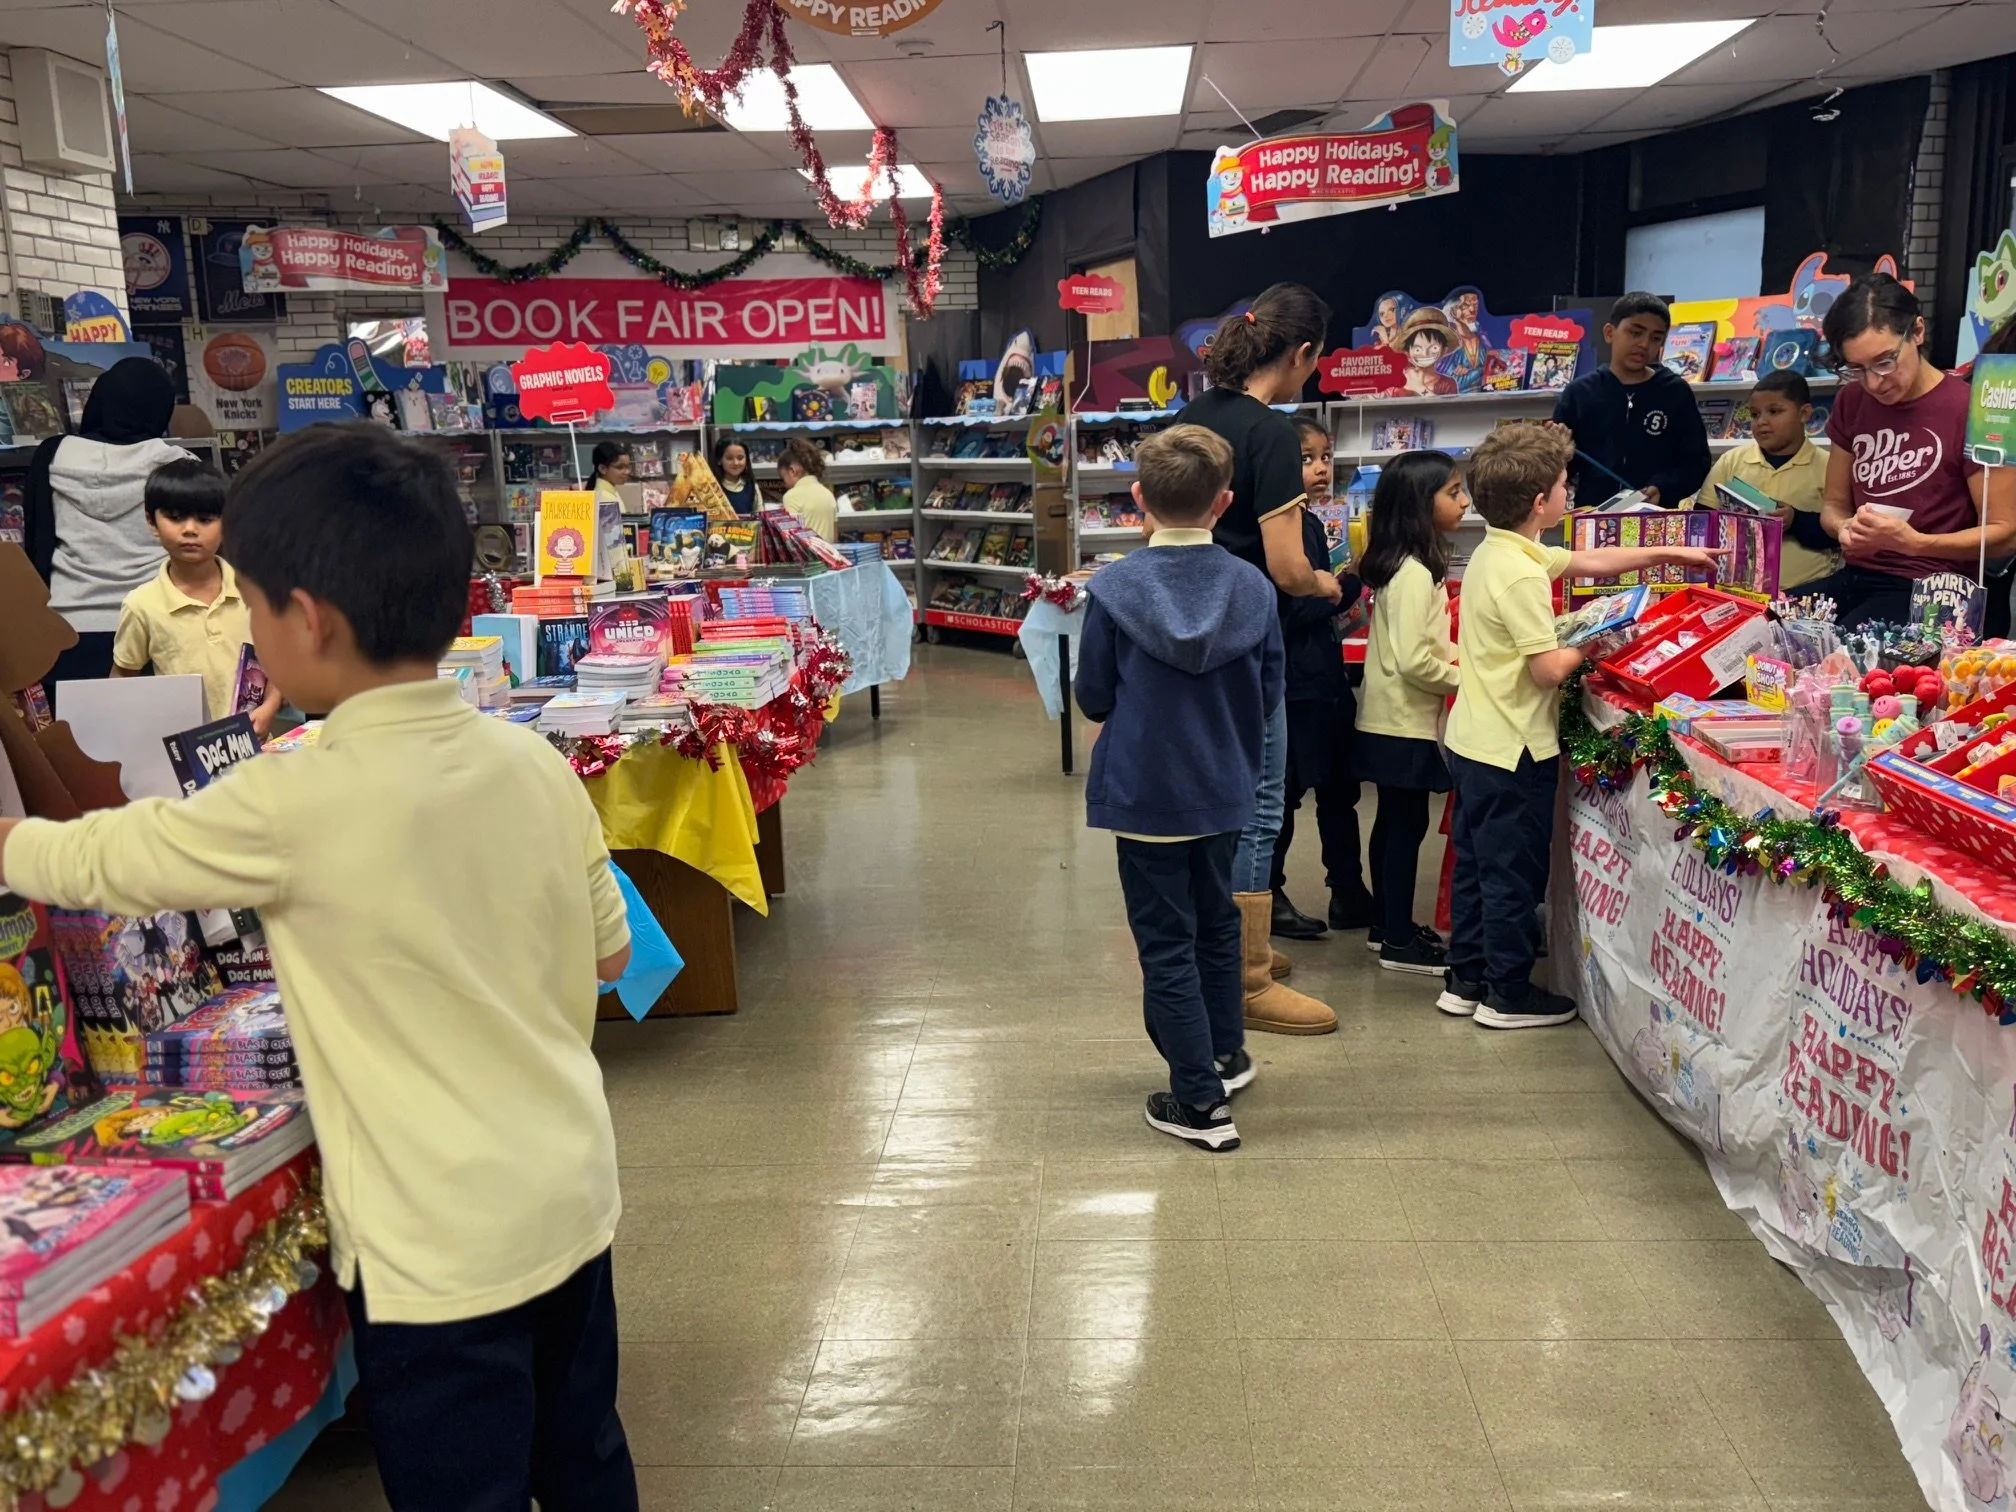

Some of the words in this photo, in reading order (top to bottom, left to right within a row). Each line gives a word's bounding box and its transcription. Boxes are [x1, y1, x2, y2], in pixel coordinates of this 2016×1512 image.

[1259, 144, 1319, 168] Happy
[1326, 140, 1409, 161] Holidays,
[1250, 166, 1319, 193] Happy
[1326, 158, 1420, 185] Reading!
[287, 234, 340, 250] Happy
[344, 237, 410, 261] Holidays,
[281, 250, 341, 269] Happy
[345, 254, 419, 280] Reading!
[1071, 286, 1089, 296] TEEN
[1089, 286, 1113, 297] READS
[449, 299, 605, 340] BOOK
[617, 300, 729, 339] FAIR
[741, 296, 883, 338] OPEN!
[69, 323, 118, 342] HAPPY
[1523, 326, 1543, 337] TEEN
[1543, 328, 1570, 340] READS
[1340, 355, 1384, 367] FAVORITE
[519, 370, 564, 391] GRAPHIC
[564, 365, 604, 385] NOVELS
[1330, 364, 1393, 378] CHARACTERS
[286, 377, 353, 396] CREATORS
[1980, 379, 2016, 411] Cashie
[216, 399, 238, 409] New
[241, 398, 263, 409] York
[288, 397, 316, 410] START
[318, 397, 342, 410] HERE
[224, 408, 257, 420] Knicks
[1650, 415, 1661, 430] 5
[543, 501, 591, 521] JAWBREAKER
[1921, 573, 1975, 599] TWIRLY
[1932, 590, 1961, 608] PEN
[545, 622, 588, 642] STRANDE
[604, 625, 655, 640] UNICO
[954, 616, 1013, 631] SCHOLASTIC
[1757, 660, 1778, 675] DONUT
[1756, 672, 1776, 687] SHOP
[195, 738, 231, 775] DOG
[226, 731, 256, 761] MAN
[1569, 820, 1633, 885] HAPPY
[1671, 846, 1743, 928] HOLDAYS!
[1660, 905, 1723, 981] HAPPY
[215, 951, 240, 965] DOG
[227, 969, 251, 983] DOG
[252, 968, 274, 981] MAN
[1650, 930, 1726, 1033] READING!
[1799, 942, 1913, 1050] HOLIDAYS!
[266, 1052, 289, 1064] OFF!
[1802, 1013, 1896, 1115] HAPPY
[268, 1067, 291, 1079] OFF!
[1781, 1040, 1911, 1182] READNG!
